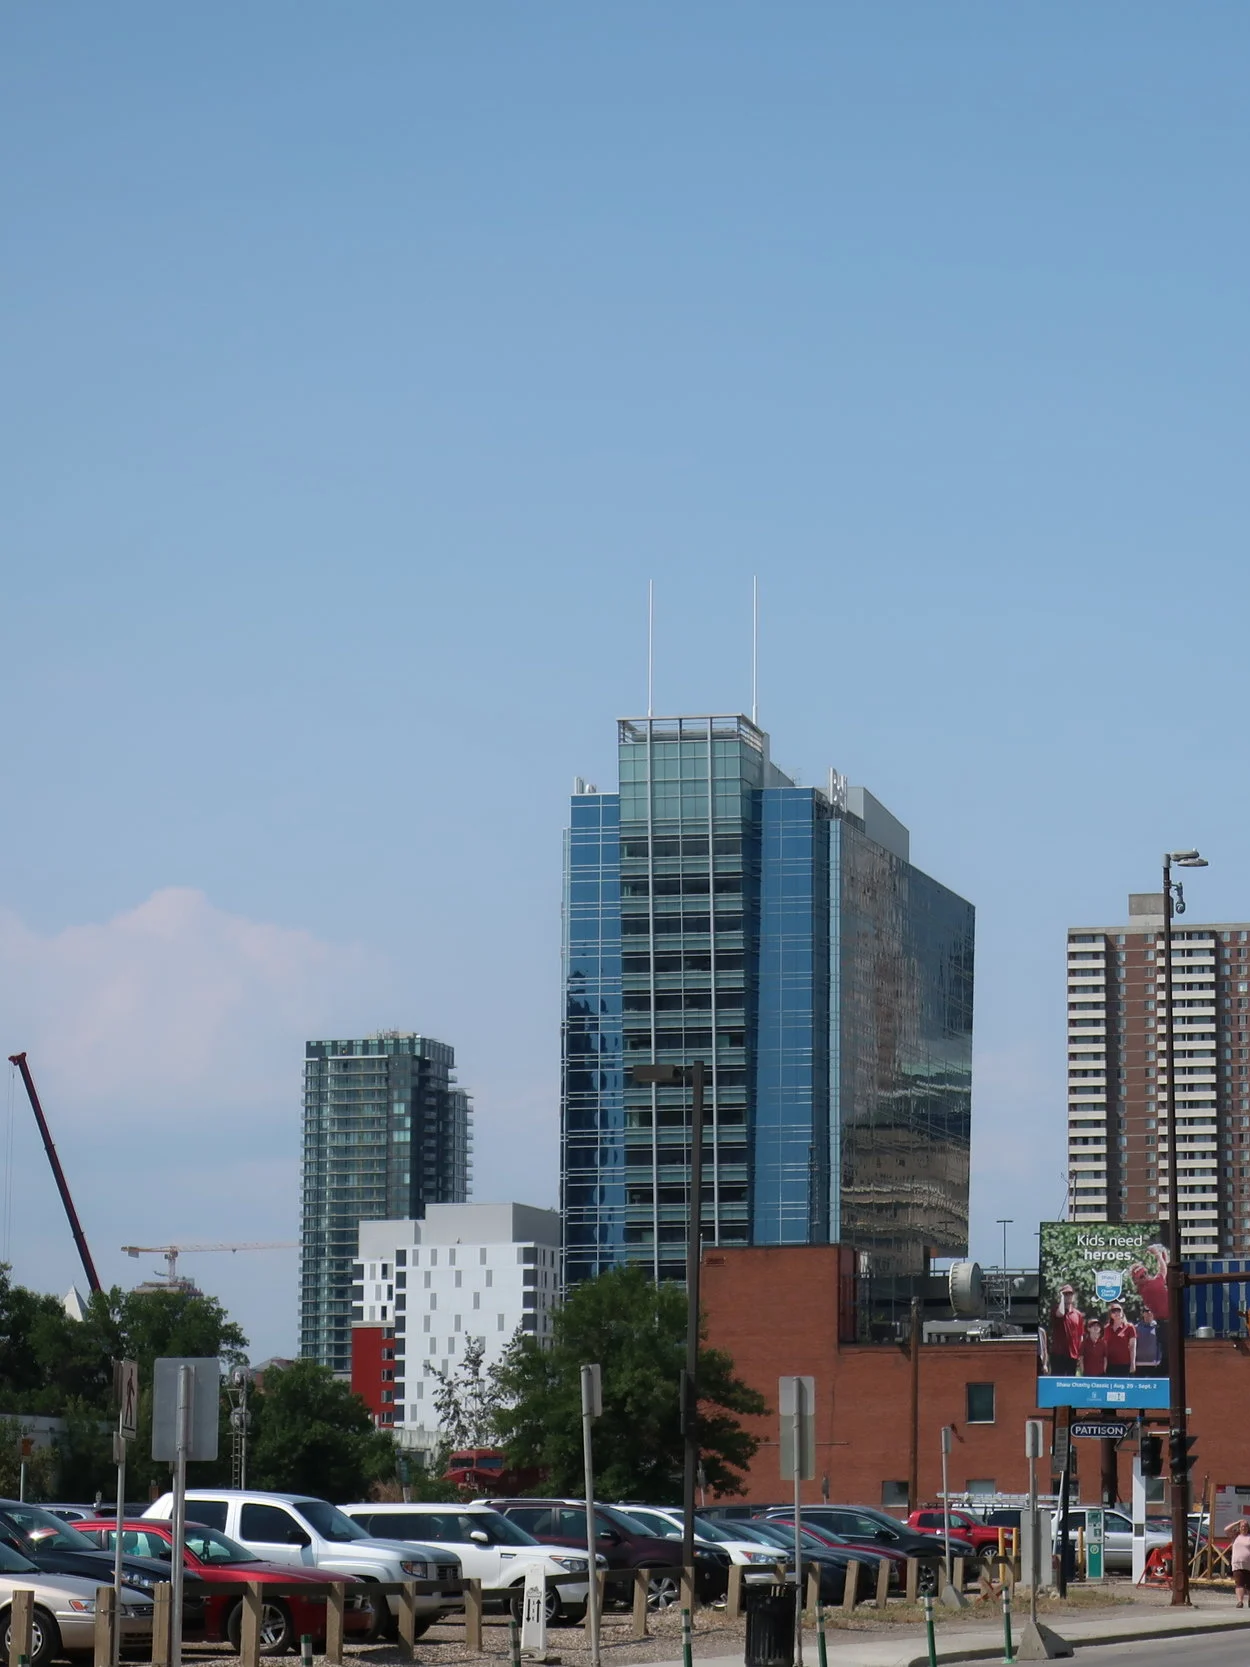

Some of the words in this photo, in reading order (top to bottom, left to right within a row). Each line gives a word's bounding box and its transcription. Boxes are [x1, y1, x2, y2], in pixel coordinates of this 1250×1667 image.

[1077, 1235, 1105, 1247] Kids
[1109, 1235, 1143, 1247] need
[1084, 1248, 1135, 1261] heroes.
[1071, 1381, 1091, 1389] Charity
[1113, 1382, 1126, 1390] Aug.
[1138, 1382, 1153, 1390] Sept.
[1075, 1426, 1124, 1435] PATTISON
